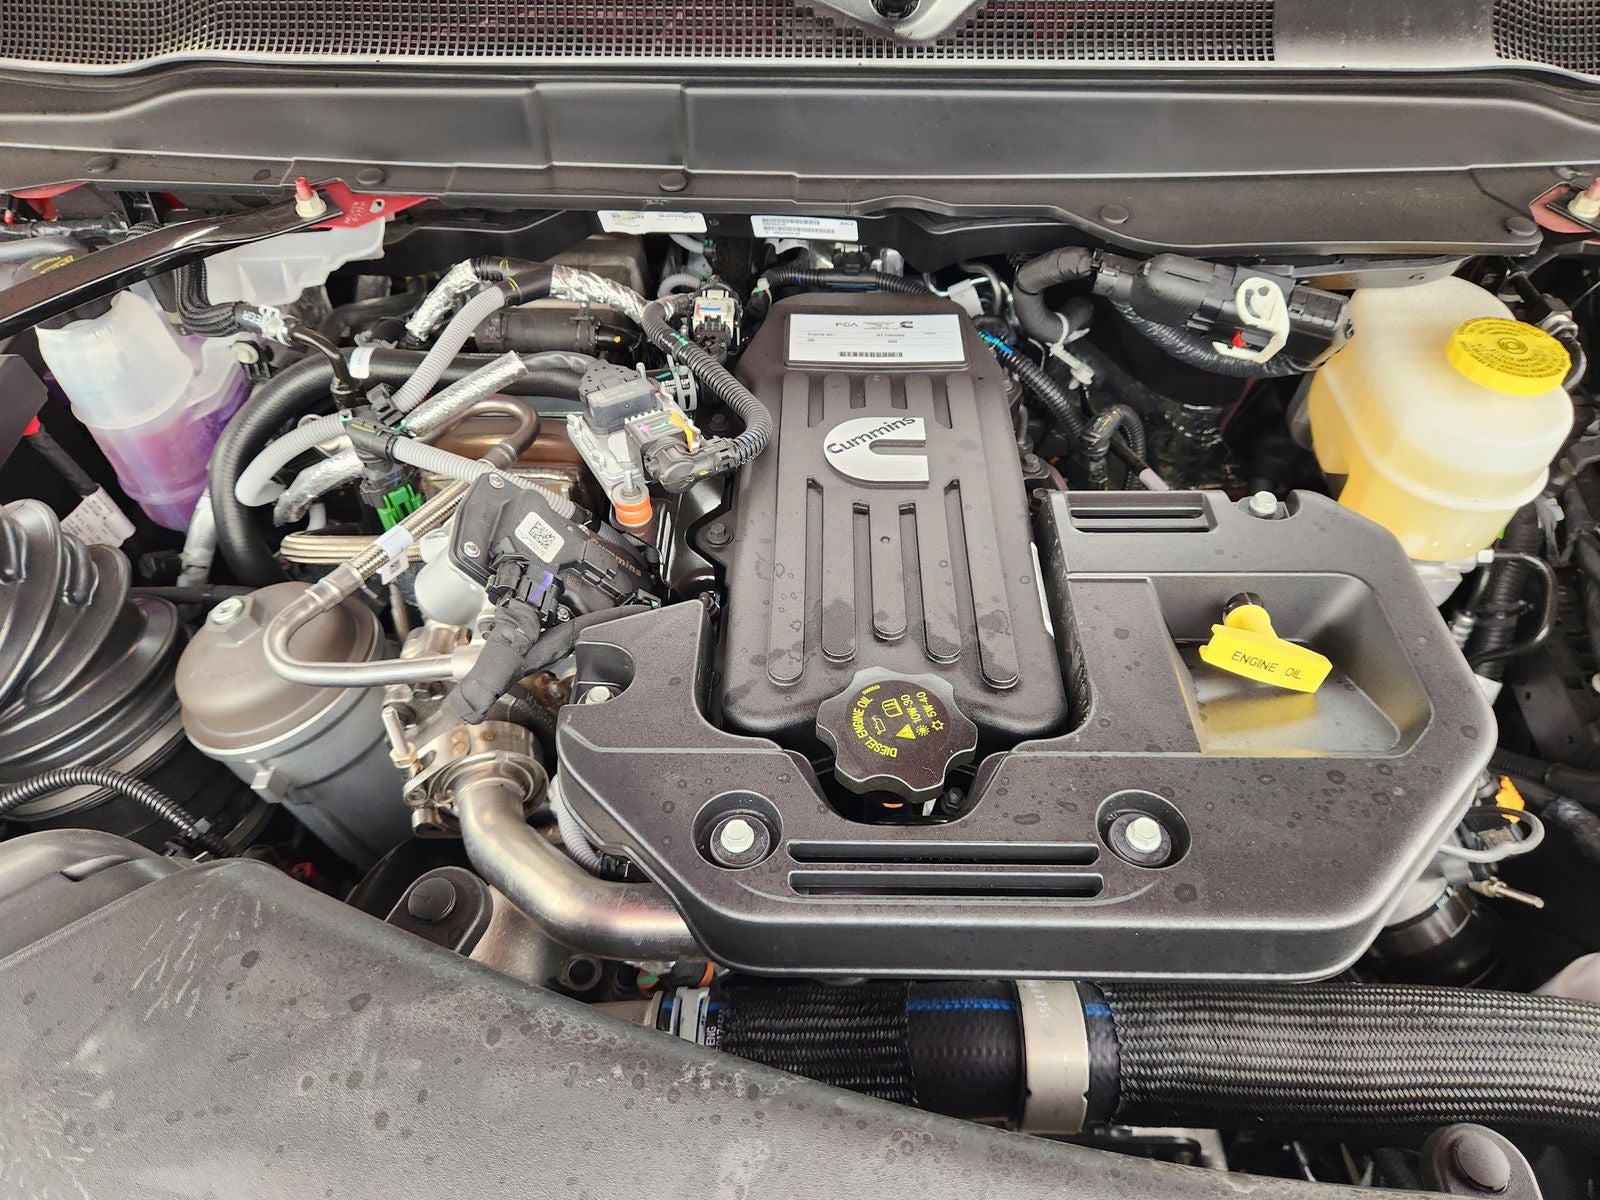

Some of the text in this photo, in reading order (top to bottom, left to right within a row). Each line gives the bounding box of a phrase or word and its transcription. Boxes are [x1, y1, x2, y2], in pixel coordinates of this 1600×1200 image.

[826, 417, 917, 454] Cummins
[1231, 651, 1302, 680] ENGINE OIL
[857, 696, 873, 710] OIL
[900, 694, 922, 723] 10W-30
[916, 691, 937, 718] 5W-40
[852, 707, 869, 739] ENGINE
[864, 736, 898, 758] DIESEL
[706, 1026, 717, 1046] ENG
